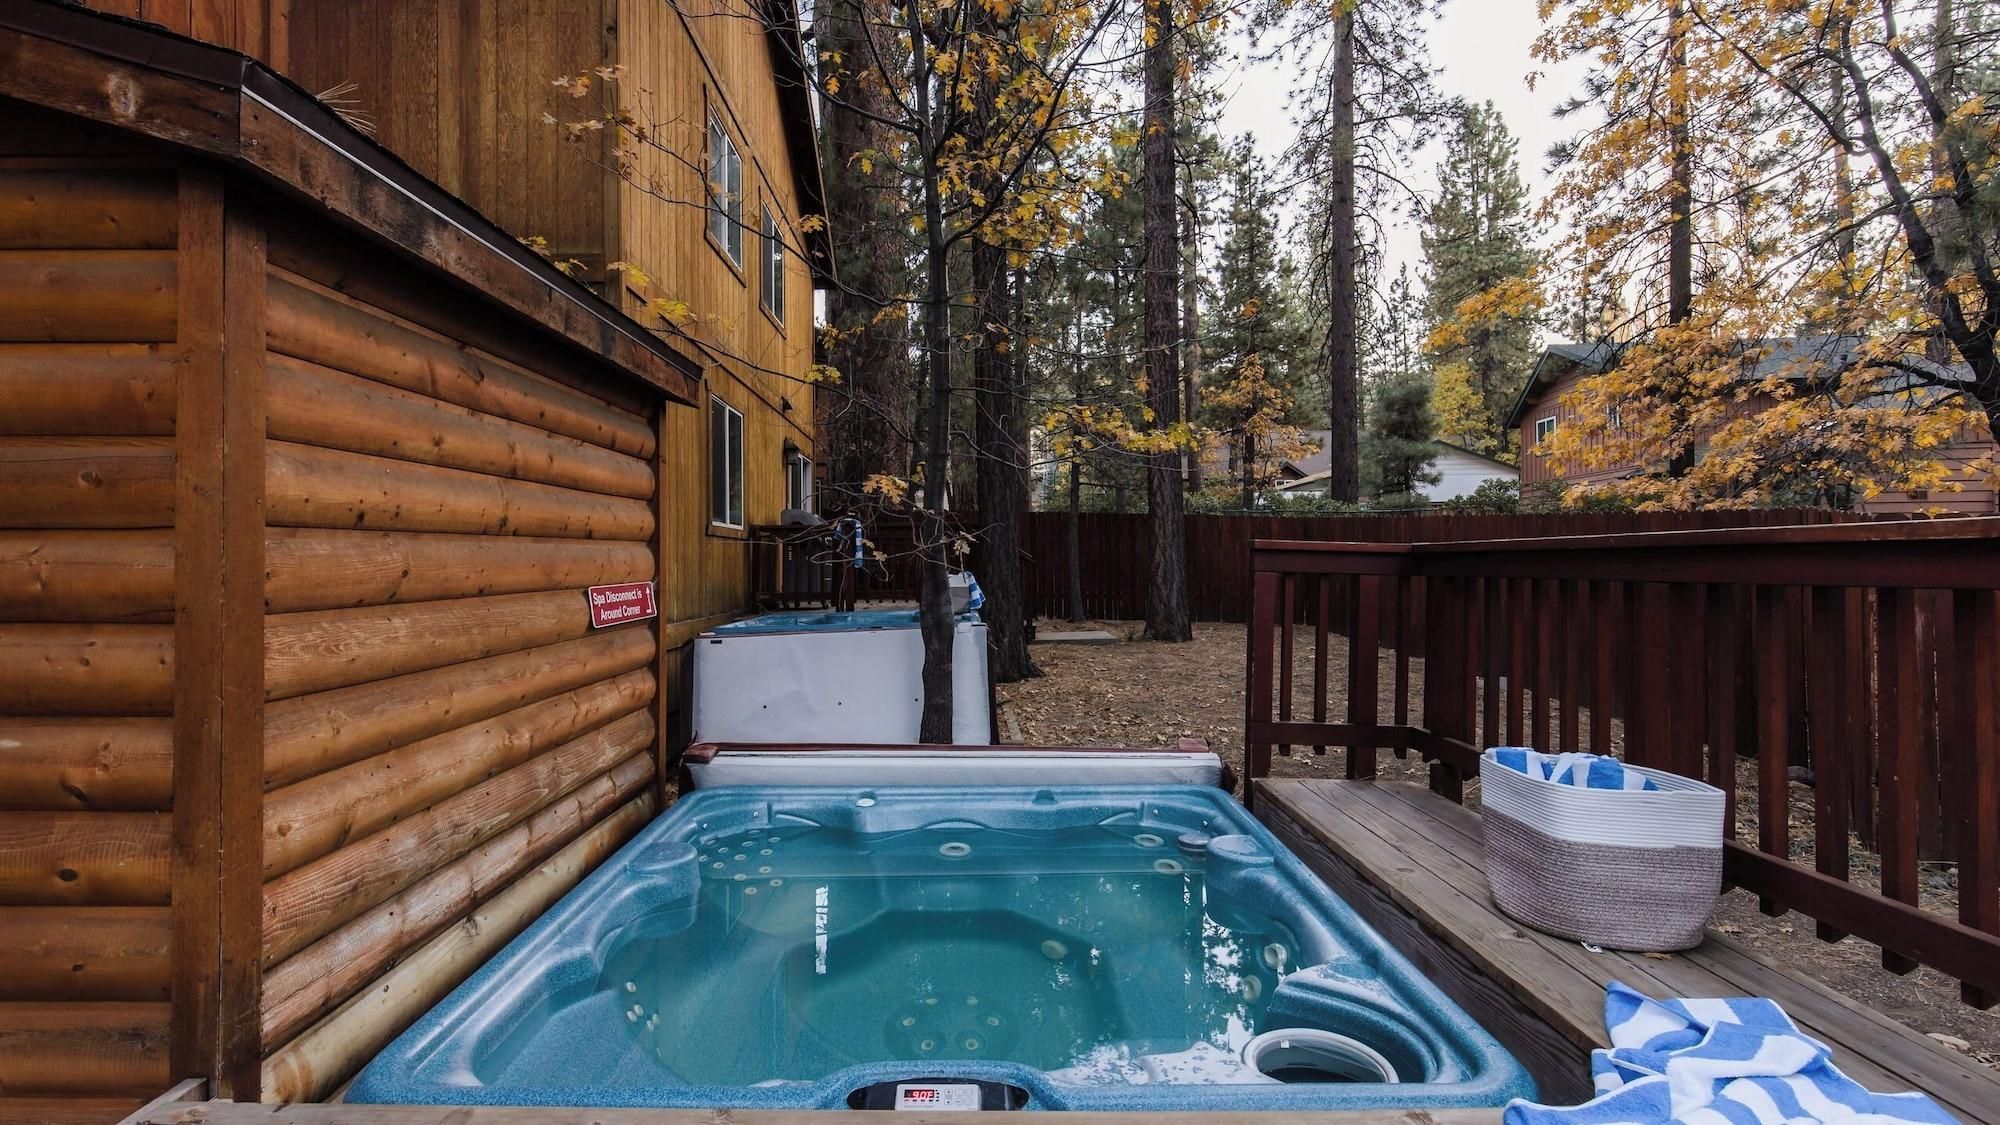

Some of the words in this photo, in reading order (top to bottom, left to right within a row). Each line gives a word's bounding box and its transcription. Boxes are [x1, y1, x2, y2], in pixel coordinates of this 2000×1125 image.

[593, 593, 606, 607] Spa
[606, 589, 637, 603] Disconnect
[636, 588, 642, 599] is
[600, 606, 622, 620] Around
[622, 605, 640, 616] Corner
